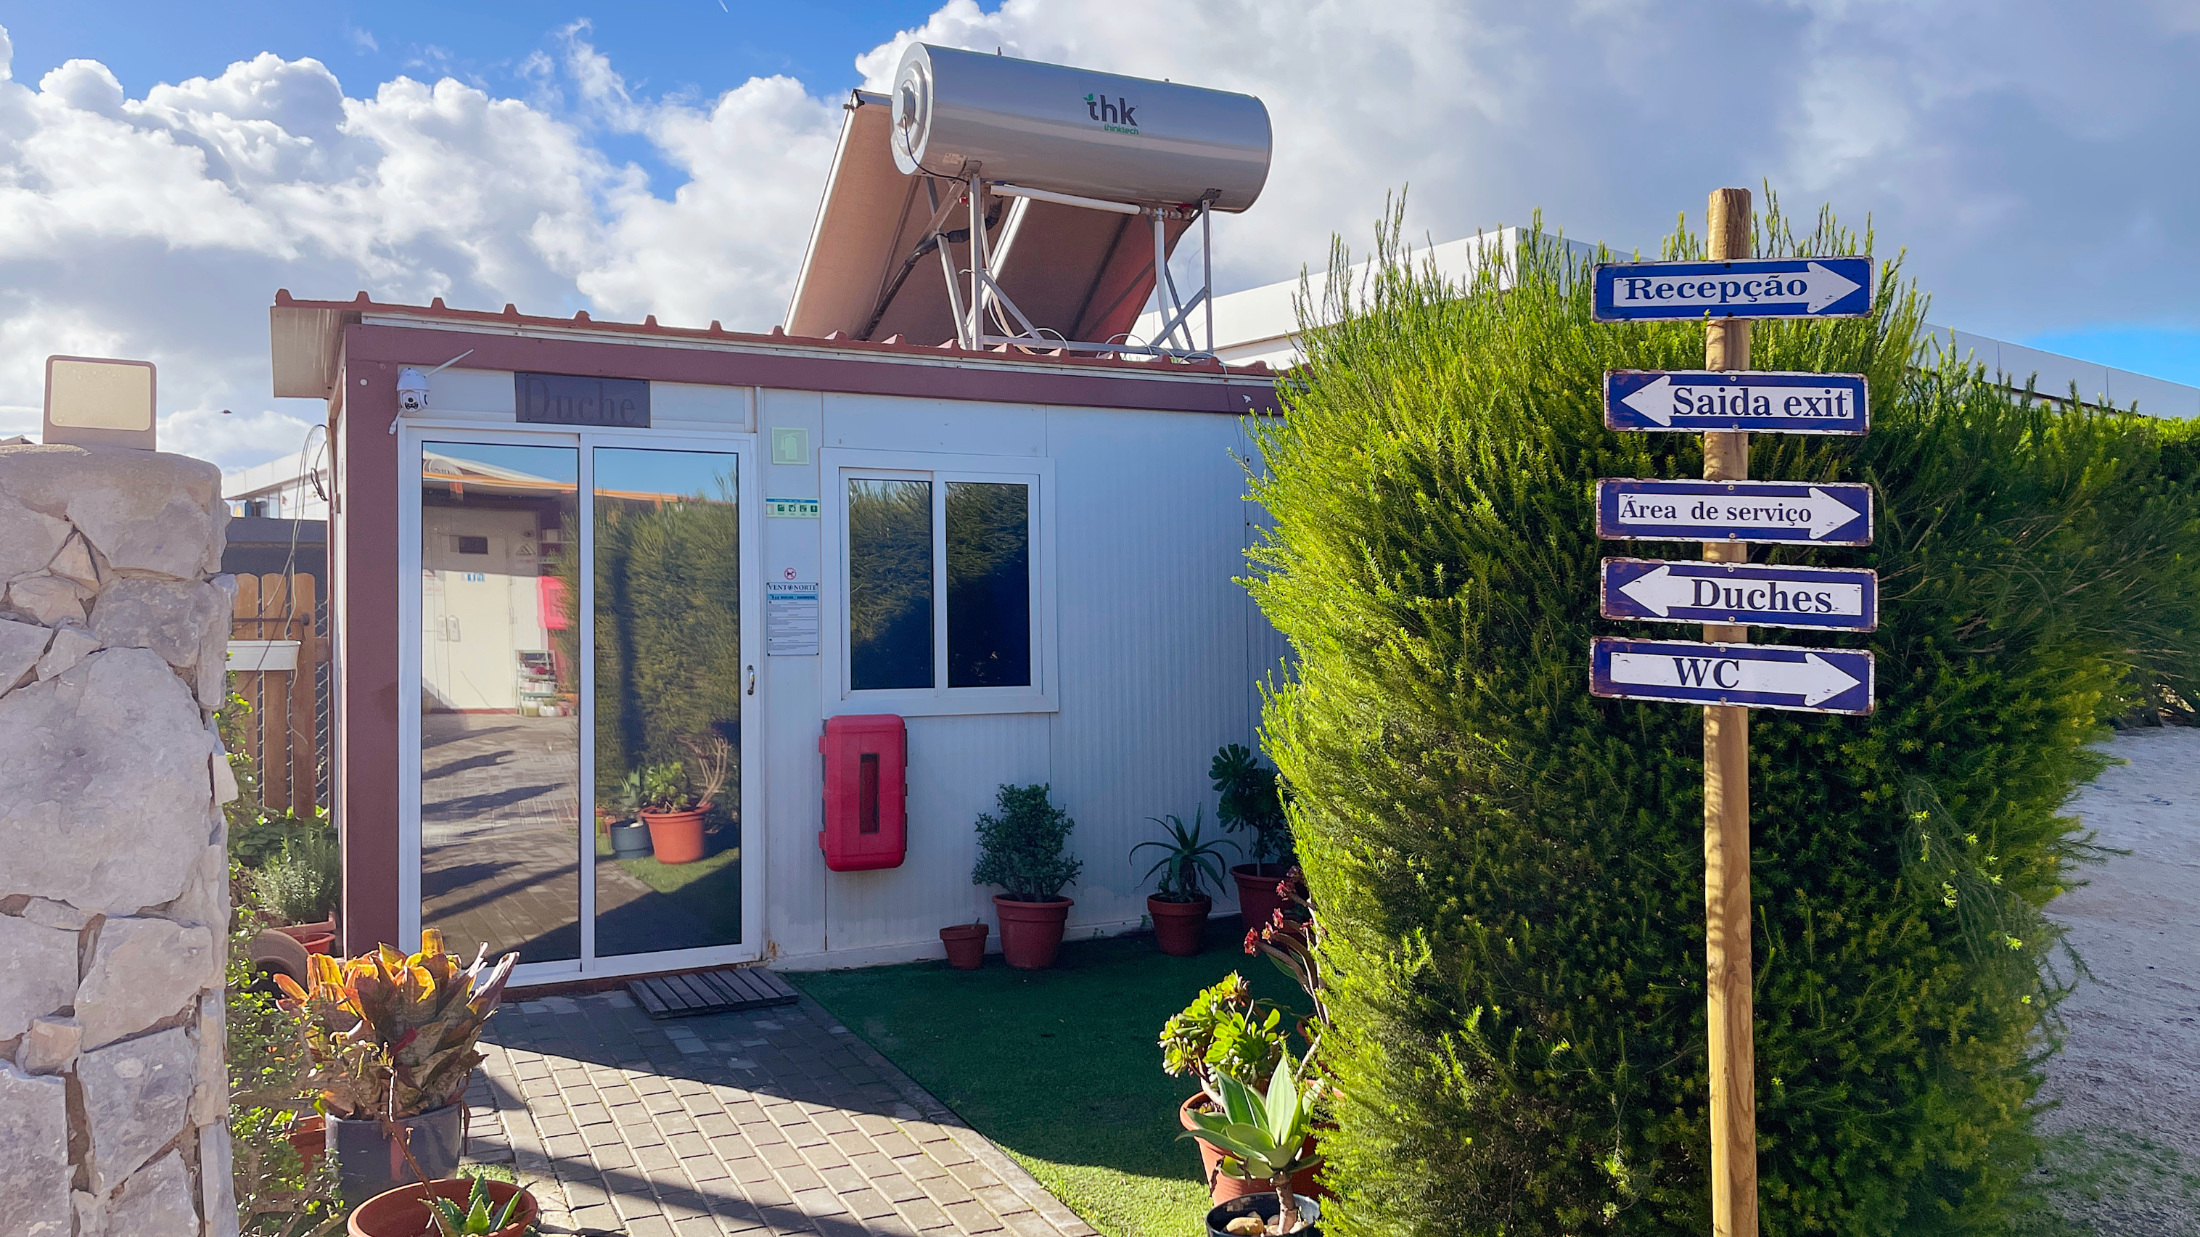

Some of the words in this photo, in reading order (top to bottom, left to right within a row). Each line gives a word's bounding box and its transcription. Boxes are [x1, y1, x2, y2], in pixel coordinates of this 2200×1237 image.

[1085, 94, 1138, 126] thk
[1104, 124, 1139, 135] thinktech
[1625, 275, 1808, 303] Recepção
[522, 377, 636, 424] Duche
[1673, 387, 1773, 416] Saida
[1783, 388, 1848, 418] exit
[1620, 496, 1677, 519] Área
[1690, 501, 1719, 520] de
[1726, 503, 1812, 526] serviço
[1691, 578, 1833, 614] Duches
[1672, 657, 1740, 689] WC
